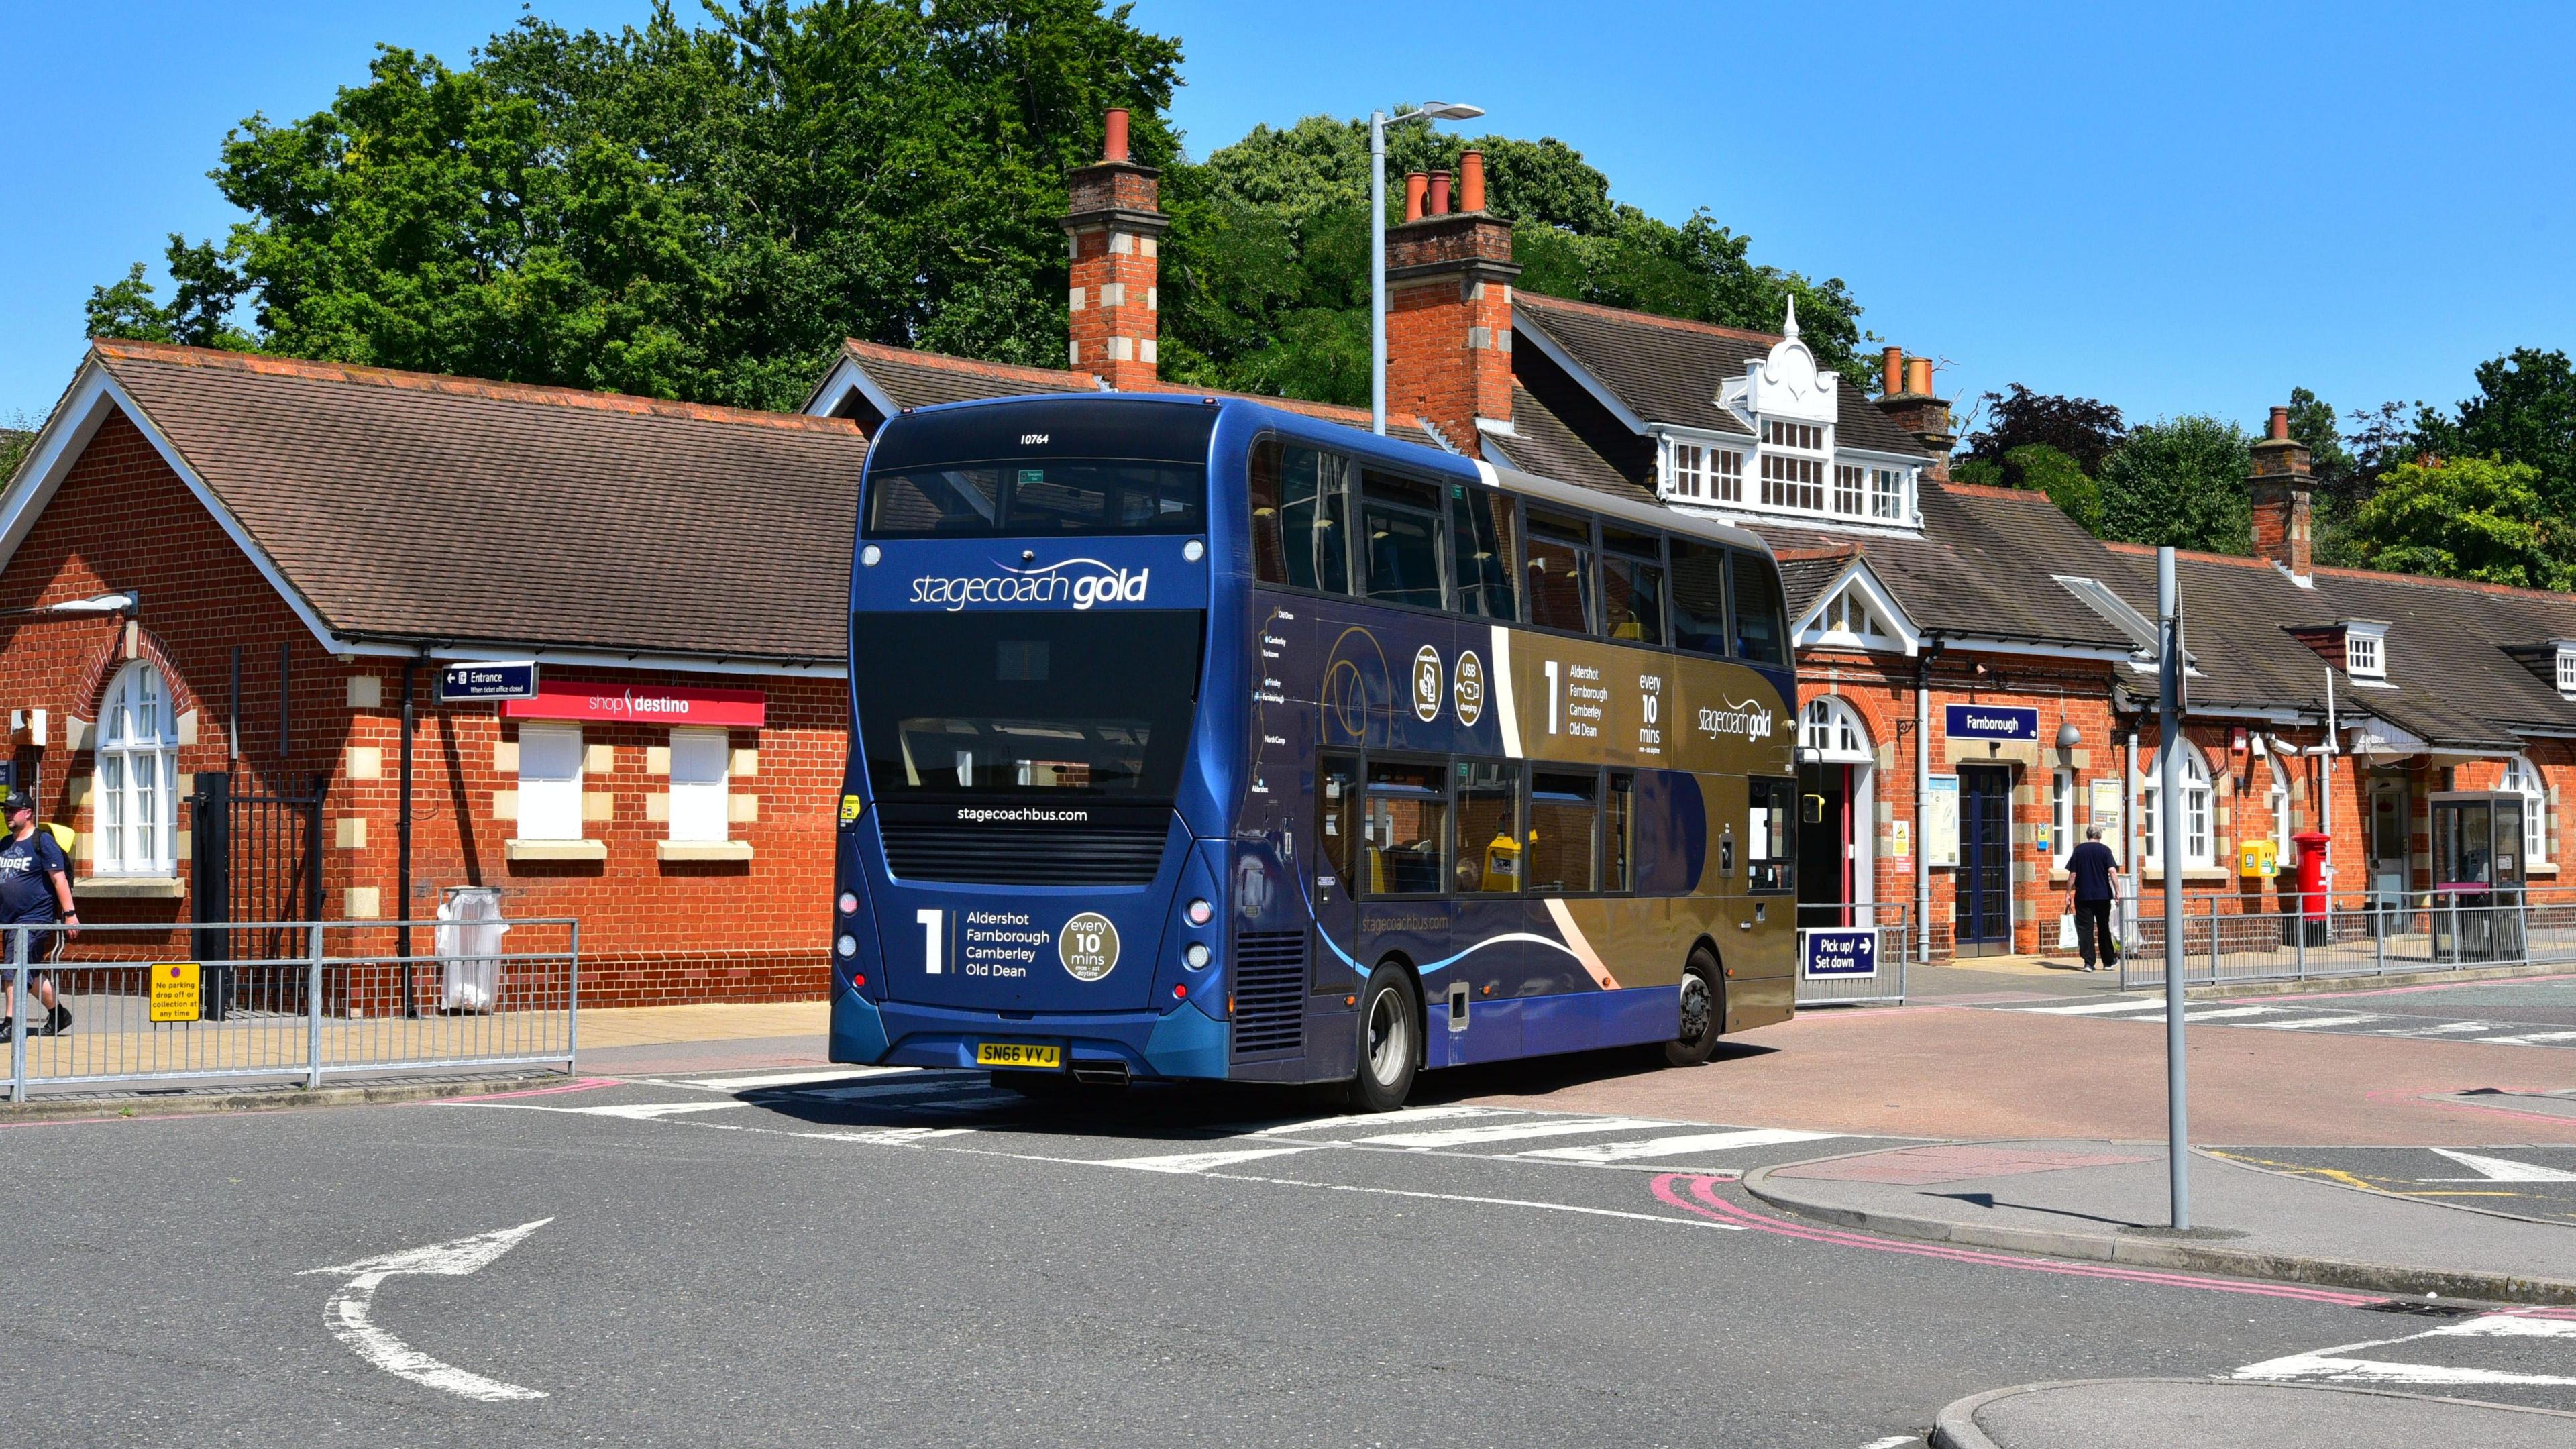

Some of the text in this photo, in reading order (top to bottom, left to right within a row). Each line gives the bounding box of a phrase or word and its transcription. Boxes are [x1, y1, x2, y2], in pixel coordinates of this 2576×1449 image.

[1021, 435, 1049, 444] 10764
[910, 568, 1149, 612] stagecoach gold
[1269, 636, 1286, 647] Camberley
[471, 672, 502, 683] Entrance
[1463, 663, 1476, 677] USB
[1570, 665, 1599, 680] Aldershot
[1269, 678, 1281, 688] Frimley
[1640, 674, 1661, 695] every
[1545, 661, 1558, 734] 1
[1570, 684, 1607, 702] Farnborough
[589, 694, 689, 714] shop destino
[1460, 703, 1477, 714] charging
[1642, 694, 1657, 724] 10
[1570, 703, 1601, 721] Camberley
[1569, 722, 1597, 737] Old Dean
[1698, 706, 1772, 743] stagecoach gold
[1966, 714, 2019, 733] Farnborough
[1275, 736, 1285, 746] Camp
[1640, 724, 1660, 744] mins
[957, 808, 1088, 822] stagecoachbus.com
[0, 857, 32, 871] UDGE
[967, 912, 1030, 925] Aldershot
[1362, 915, 1448, 935] stagecoachbus.com
[1071, 920, 1106, 934] every
[917, 909, 943, 974] 1
[967, 929, 1050, 945] Farnborough
[1076, 934, 1100, 953] 10
[1821, 939, 1838, 952] Pick
[966, 947, 1036, 963] Camberley
[1071, 952, 1105, 965] mins
[1815, 955, 1854, 969] Set down
[966, 963, 1026, 977] Old Dean
[984, 1045, 1054, 1063] SN66 VYJ
